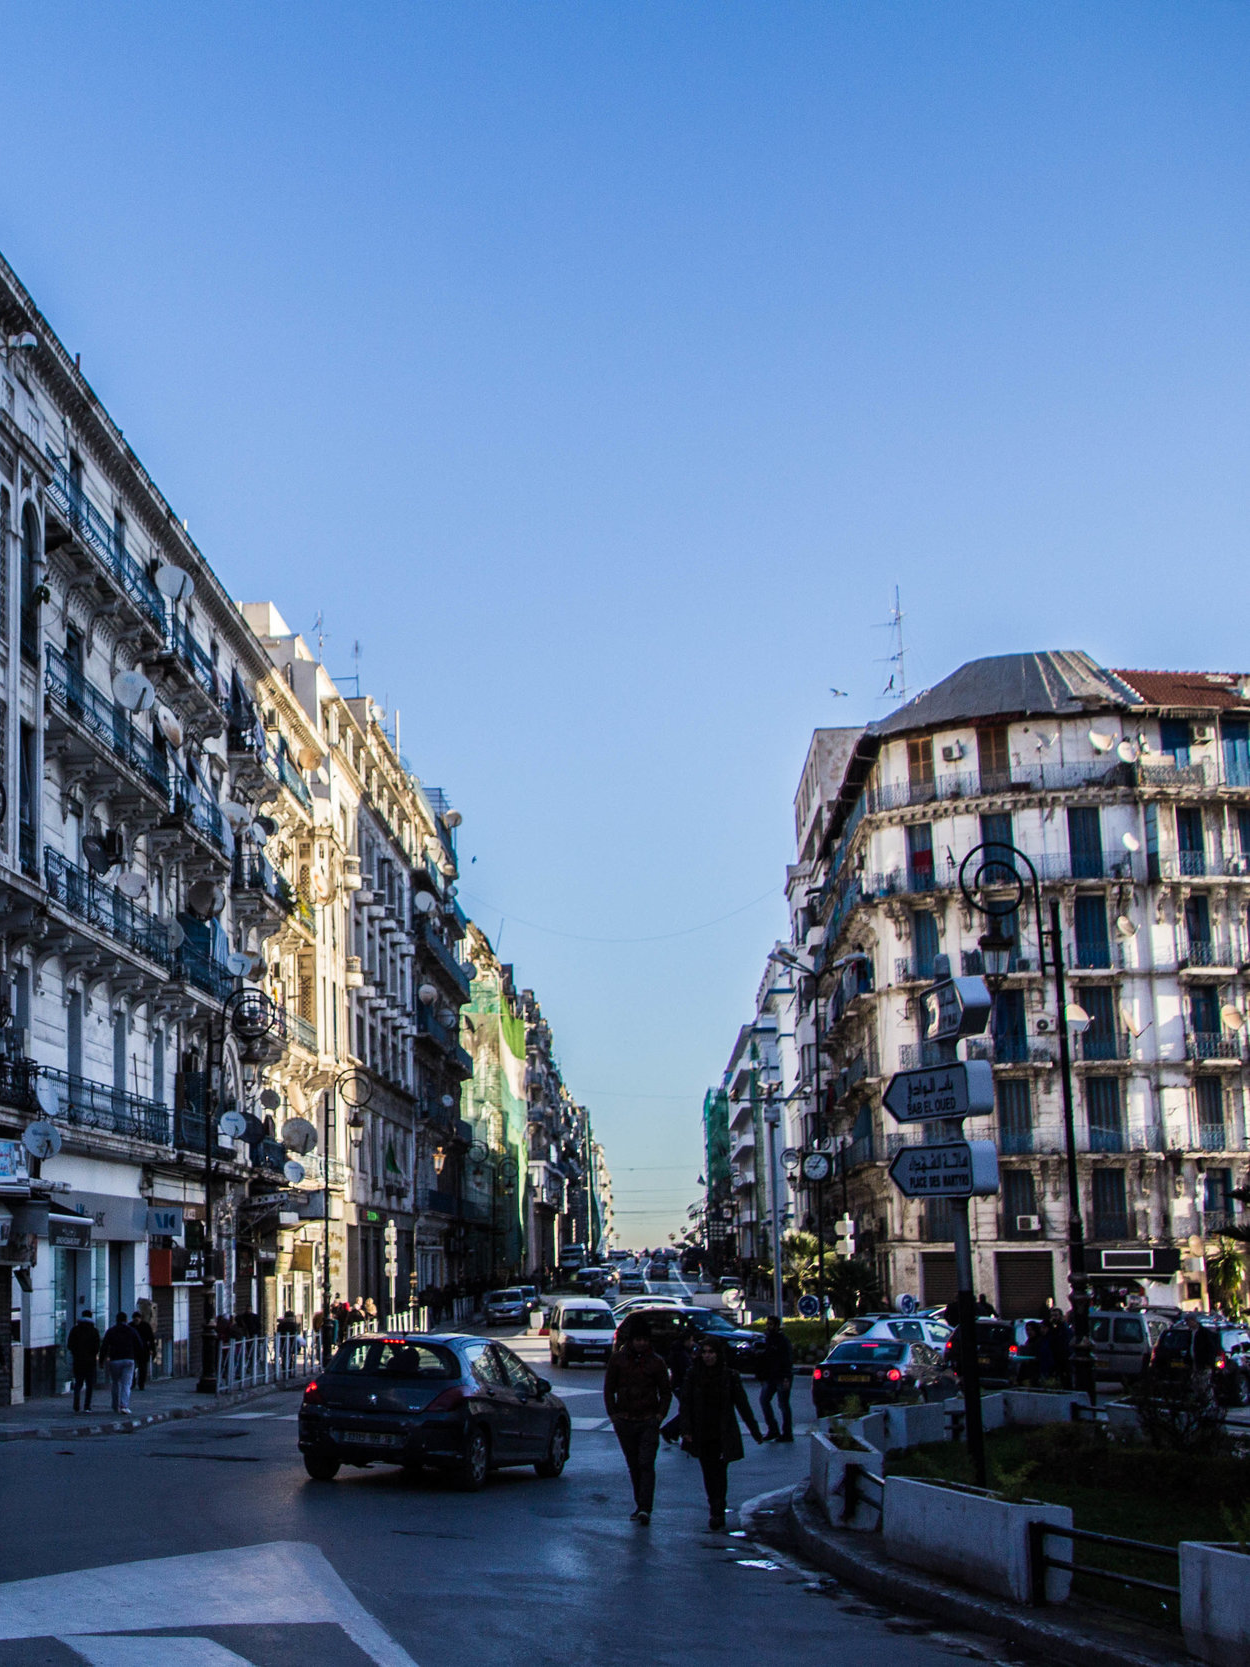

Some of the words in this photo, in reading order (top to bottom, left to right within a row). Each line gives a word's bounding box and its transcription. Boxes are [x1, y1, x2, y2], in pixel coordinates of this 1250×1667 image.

[907, 1101, 923, 1115] BAB
[924, 1100, 934, 1113] EL
[934, 1097, 956, 1112] OUED
[910, 1176, 927, 1188] PLACE
[929, 1175, 940, 1187] DES
[942, 1174, 969, 1186] MARTYRS
